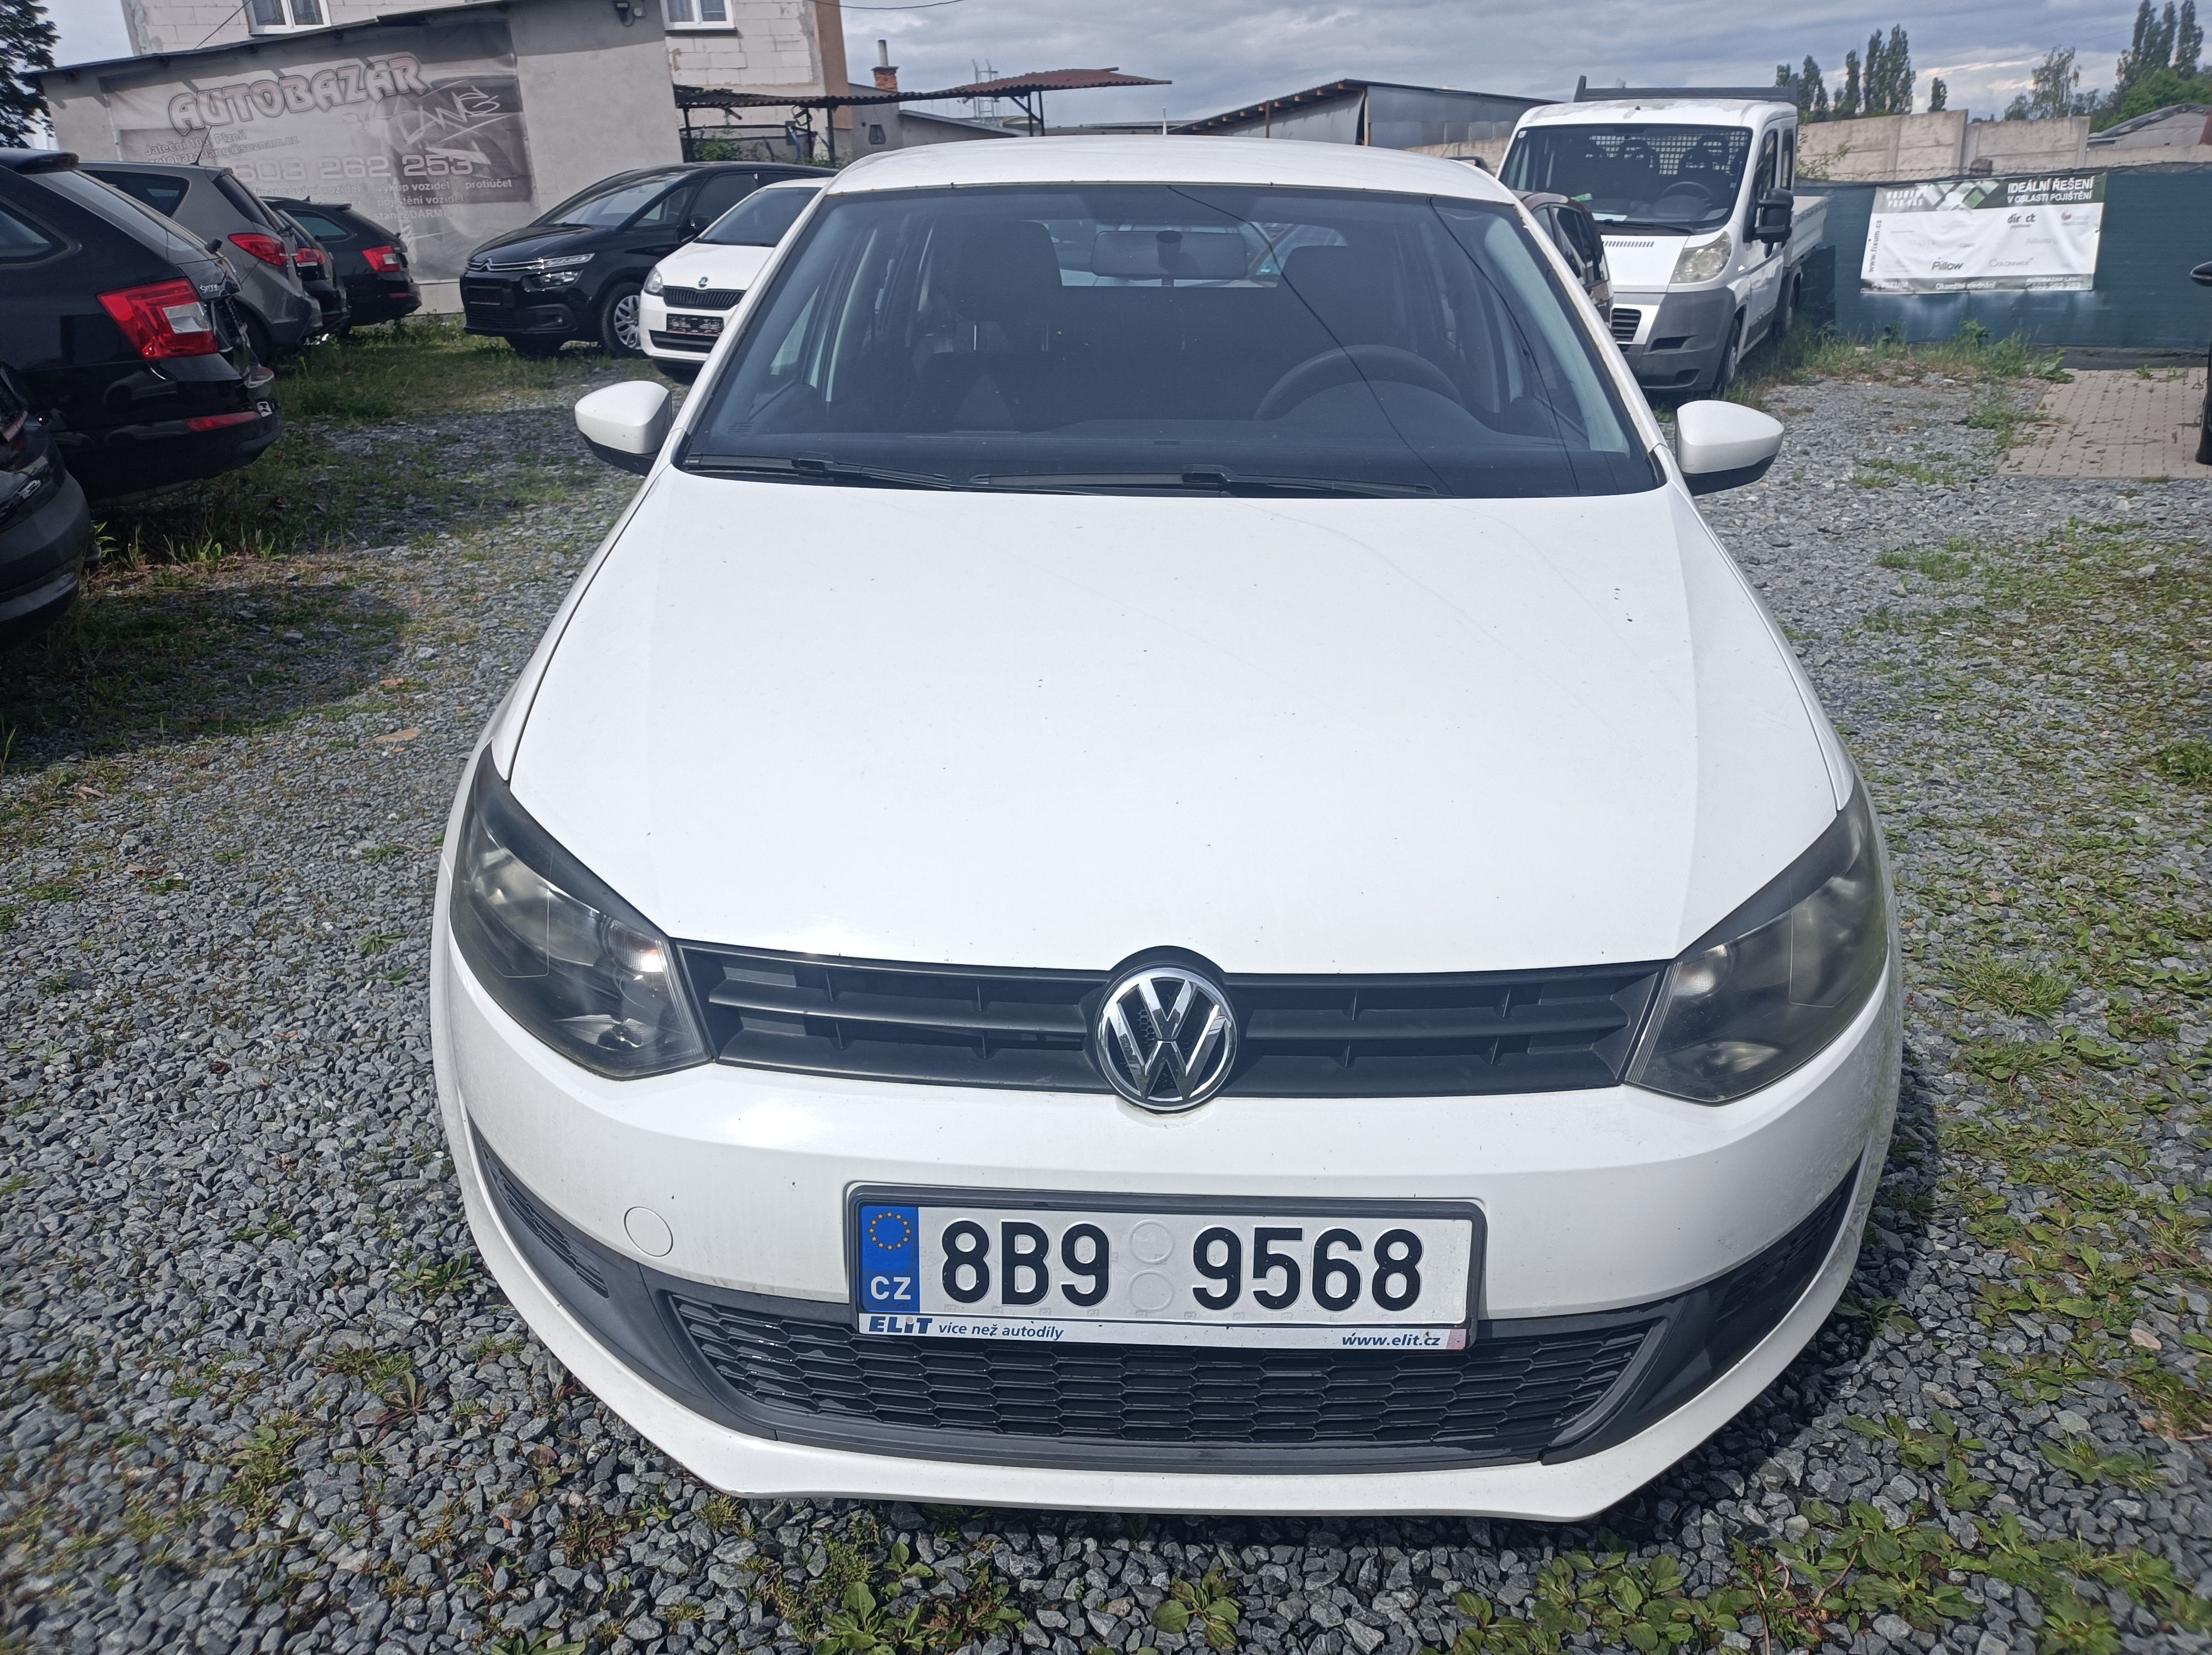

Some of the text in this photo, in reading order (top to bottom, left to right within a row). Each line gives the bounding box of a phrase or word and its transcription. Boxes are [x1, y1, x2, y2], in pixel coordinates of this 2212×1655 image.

[168, 56, 428, 137] AUTOBAZAR
[214, 129, 247, 144] Plzeň
[319, 155, 391, 179] 262
[401, 154, 473, 176] 253
[411, 180, 451, 191] vozidel
[465, 178, 513, 191] protiúčet
[2007, 175, 2096, 194] IDEÁLNÍ ŘEŠENÍ
[425, 194, 464, 205] vozidel
[2015, 194, 2049, 203] OBLASTI
[2050, 190, 2094, 201] POJIŠTĚNÍ
[1931, 259, 1964, 270] Pillow
[941, 1220, 1423, 1311] 8B9 9568
[870, 1276, 912, 1300] CZ
[938, 1321, 967, 1334] více
[972, 1323, 998, 1336] než
[1001, 1325, 1064, 1341] autodíly
[1342, 1334, 1441, 1346] www.elit.cz
